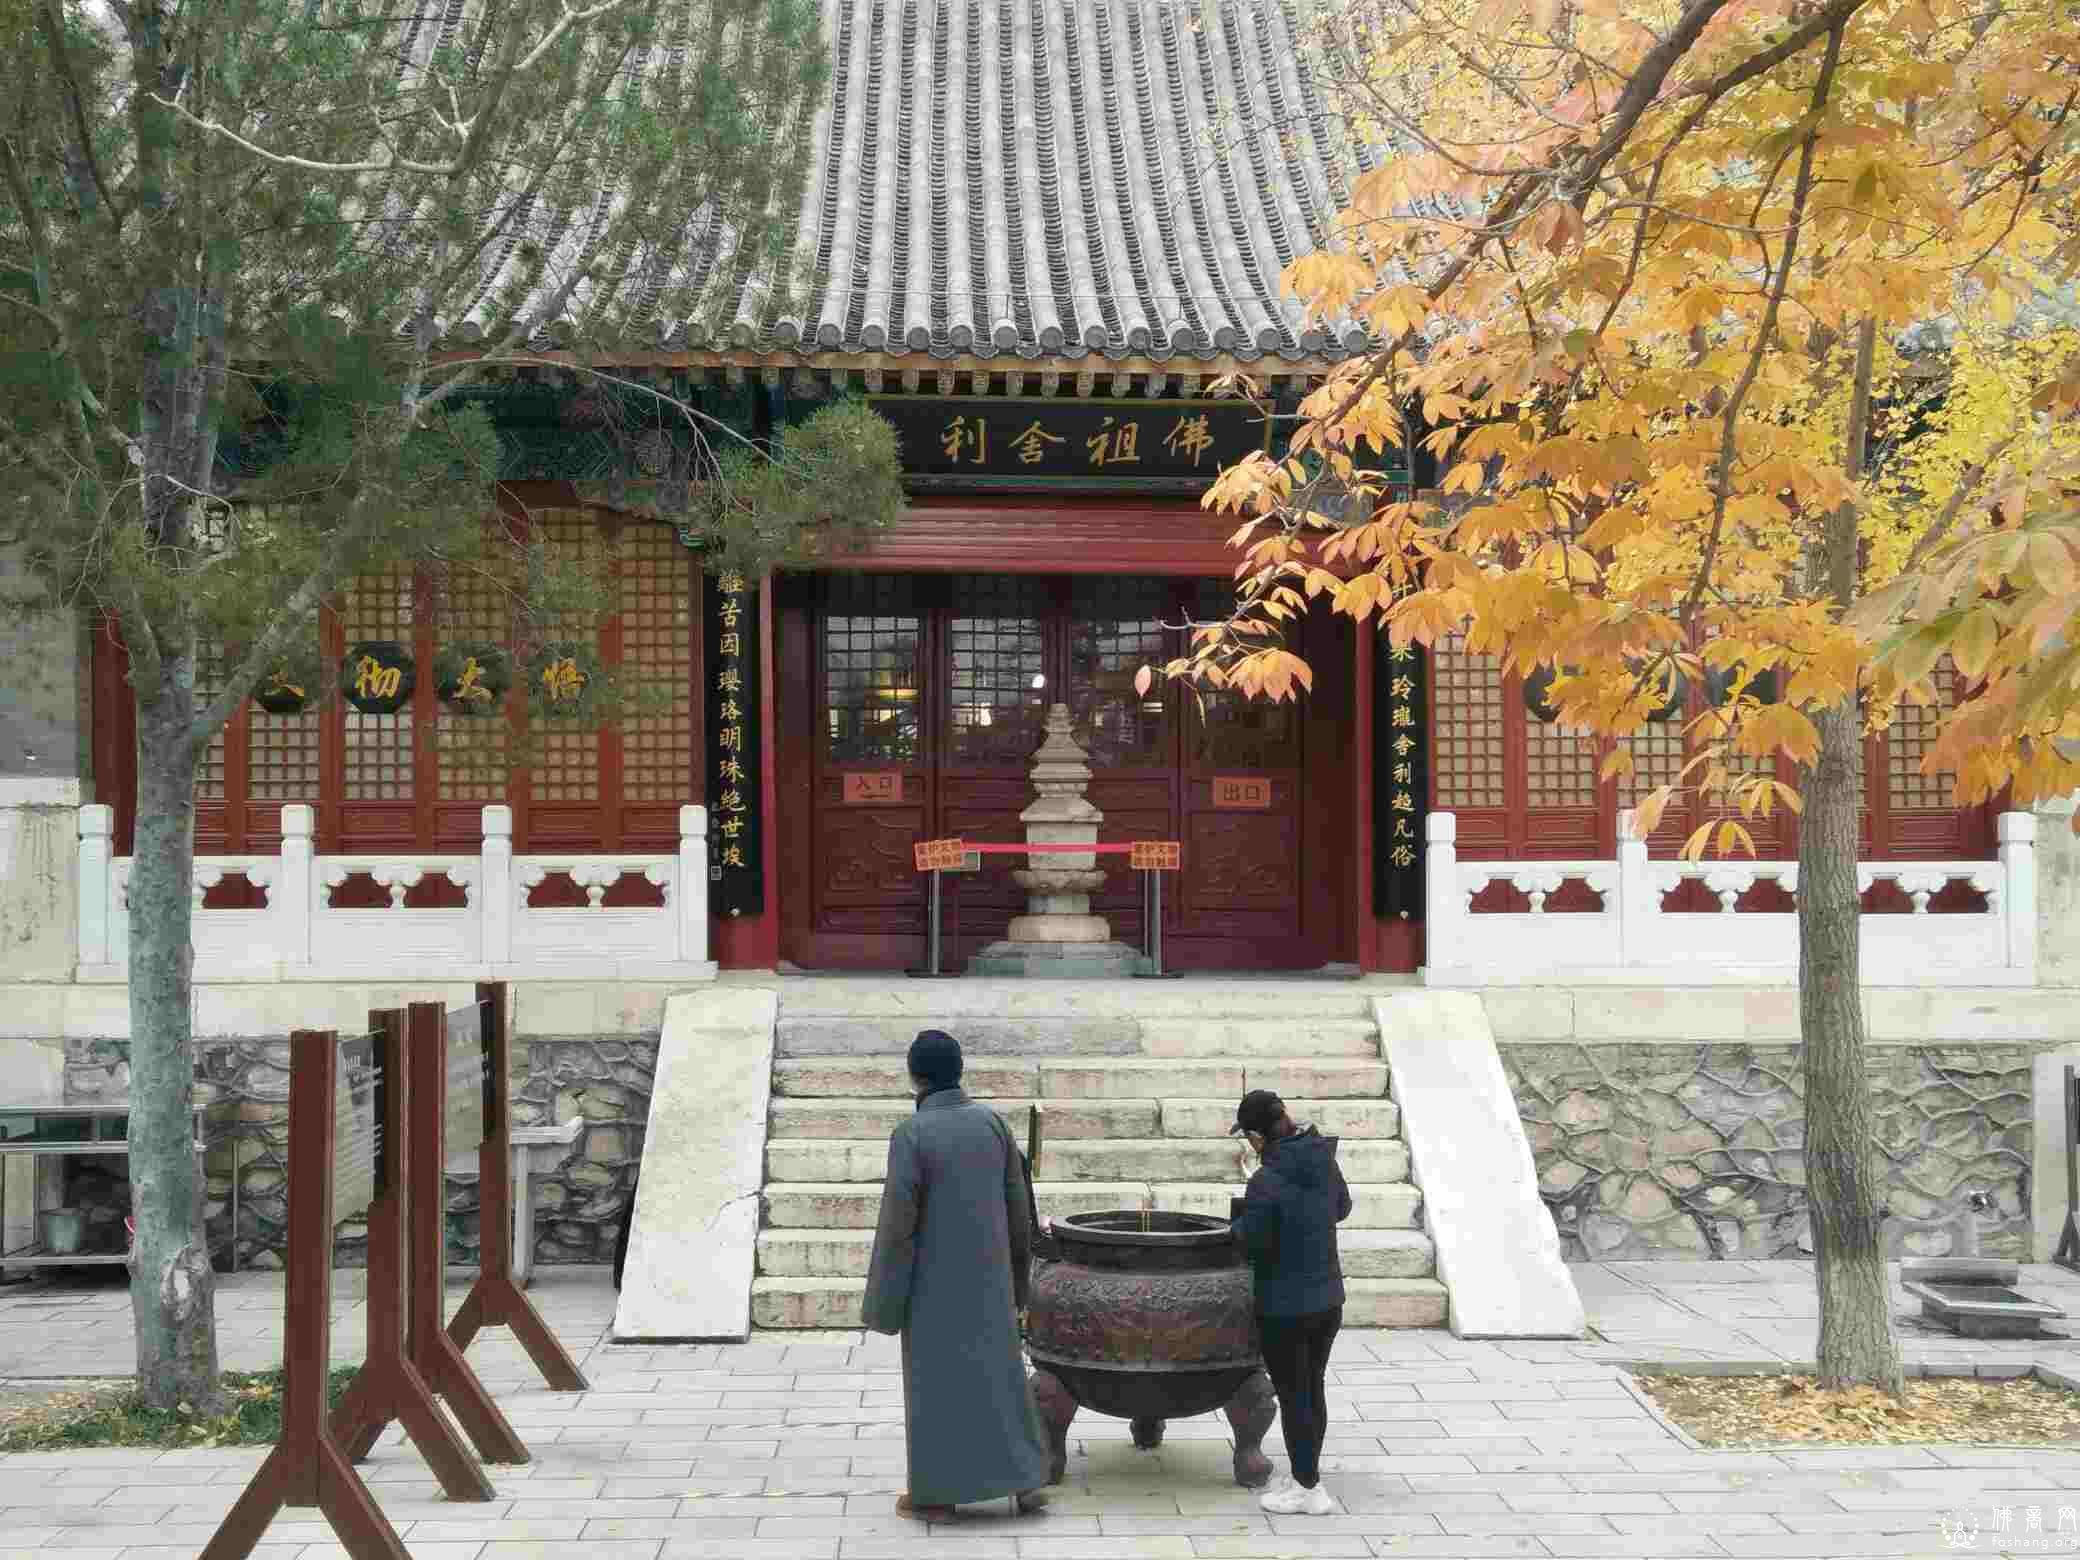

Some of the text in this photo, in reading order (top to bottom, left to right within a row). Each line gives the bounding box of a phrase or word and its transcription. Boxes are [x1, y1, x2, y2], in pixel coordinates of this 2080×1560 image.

[940, 415, 1215, 467] 佛祖舍利
[855, 776, 893, 793] 入口
[1223, 783, 1262, 801] 出口
